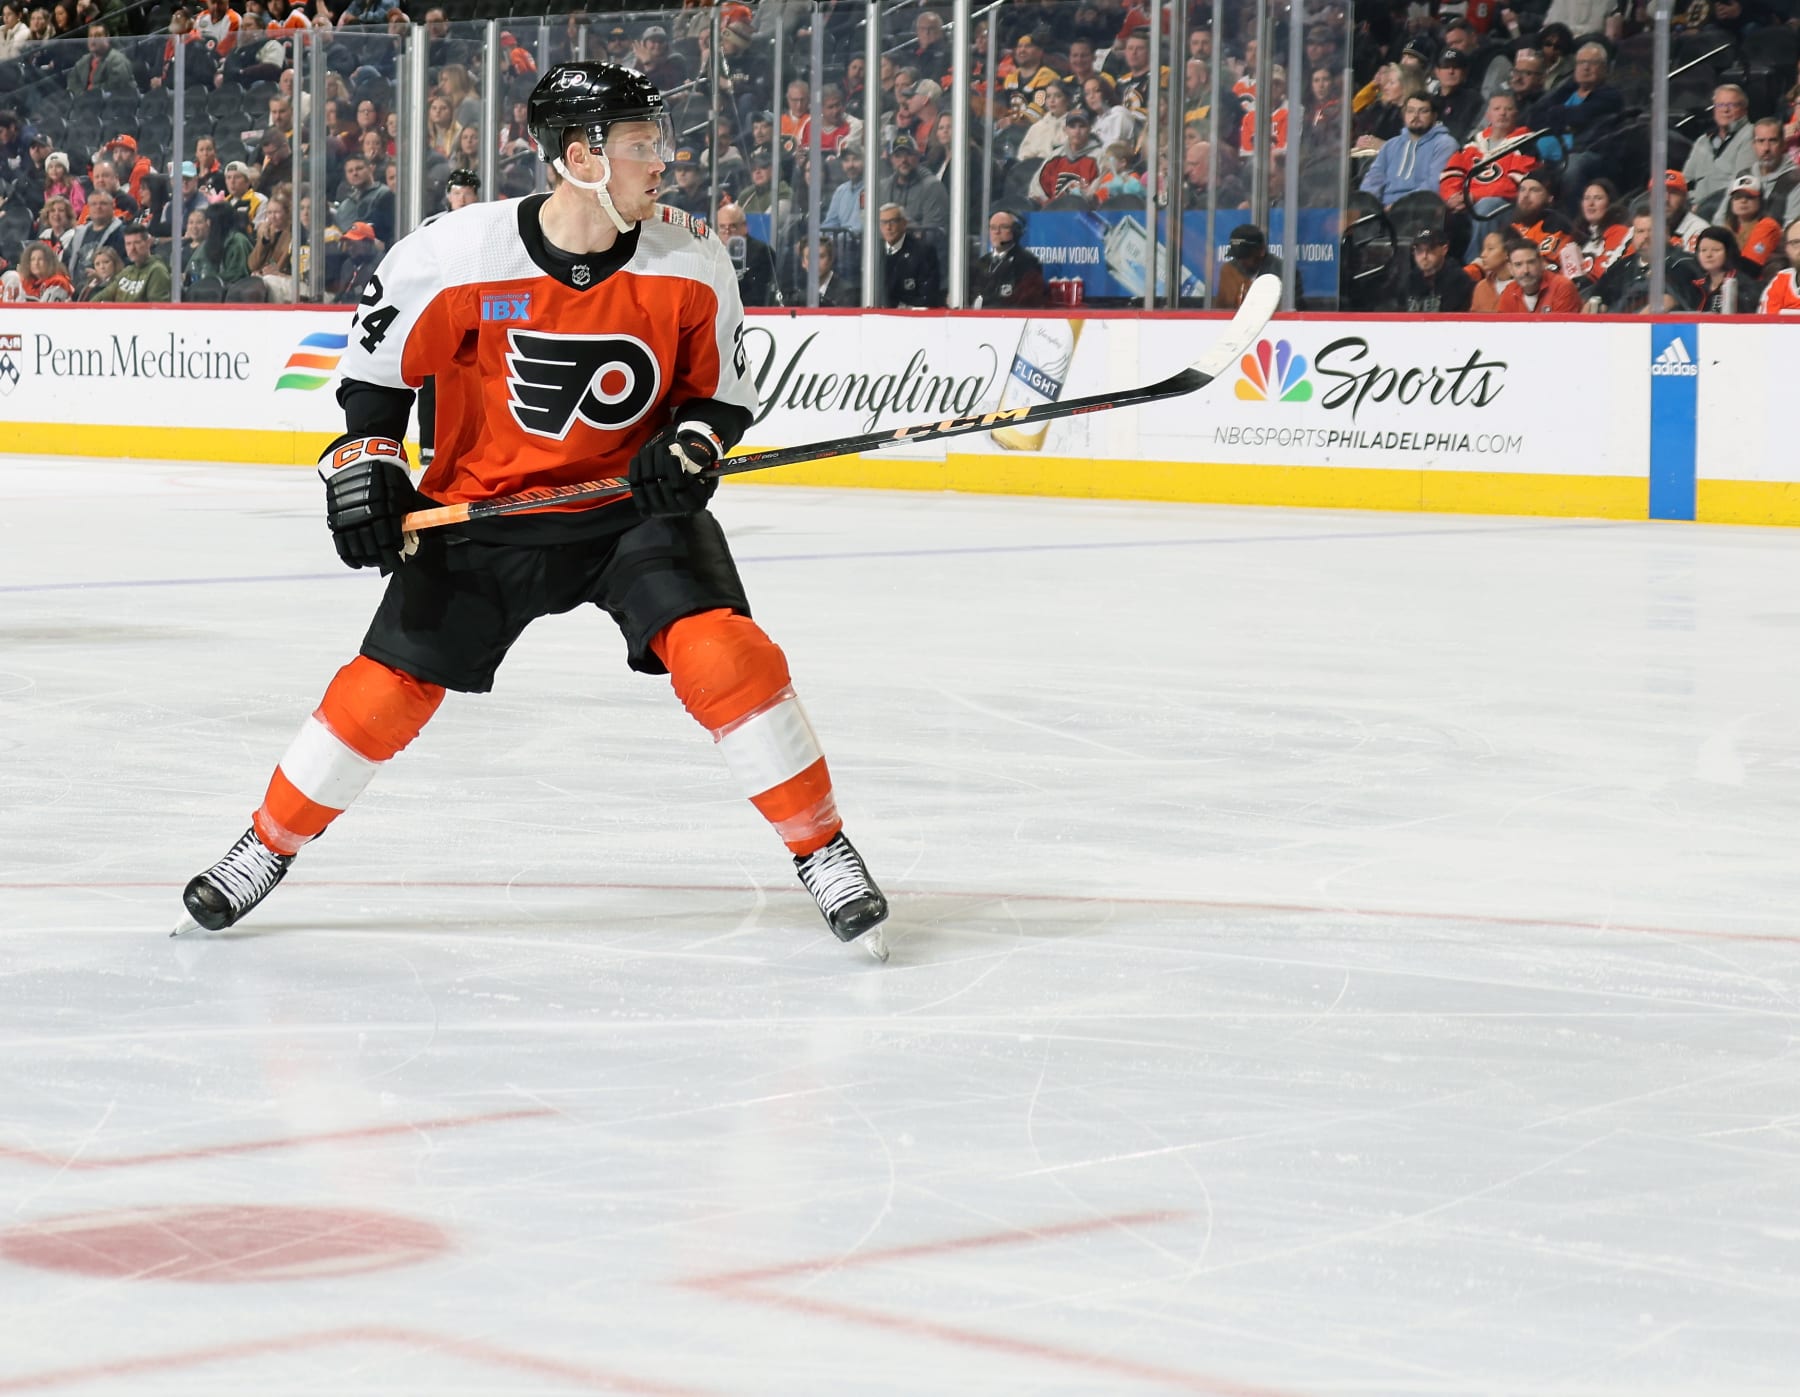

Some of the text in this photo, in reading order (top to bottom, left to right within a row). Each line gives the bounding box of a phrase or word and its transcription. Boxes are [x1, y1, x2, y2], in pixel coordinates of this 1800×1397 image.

[647, 95, 661, 103] CC
[1069, 246, 1100, 264] VODKA
[1303, 244, 1334, 262] VODKA
[483, 299, 530, 320] IBX
[34, 332, 250, 380] Penn Medicine
[1652, 361, 1698, 376] adidas
[743, 327, 997, 434] Yuengling
[1014, 360, 1058, 397] FLIGHT
[1314, 336, 1508, 425] Sports
[893, 406, 1031, 440] CCM
[1213, 425, 1523, 454] NBCSPORTSPHILADELPHIA.COM
